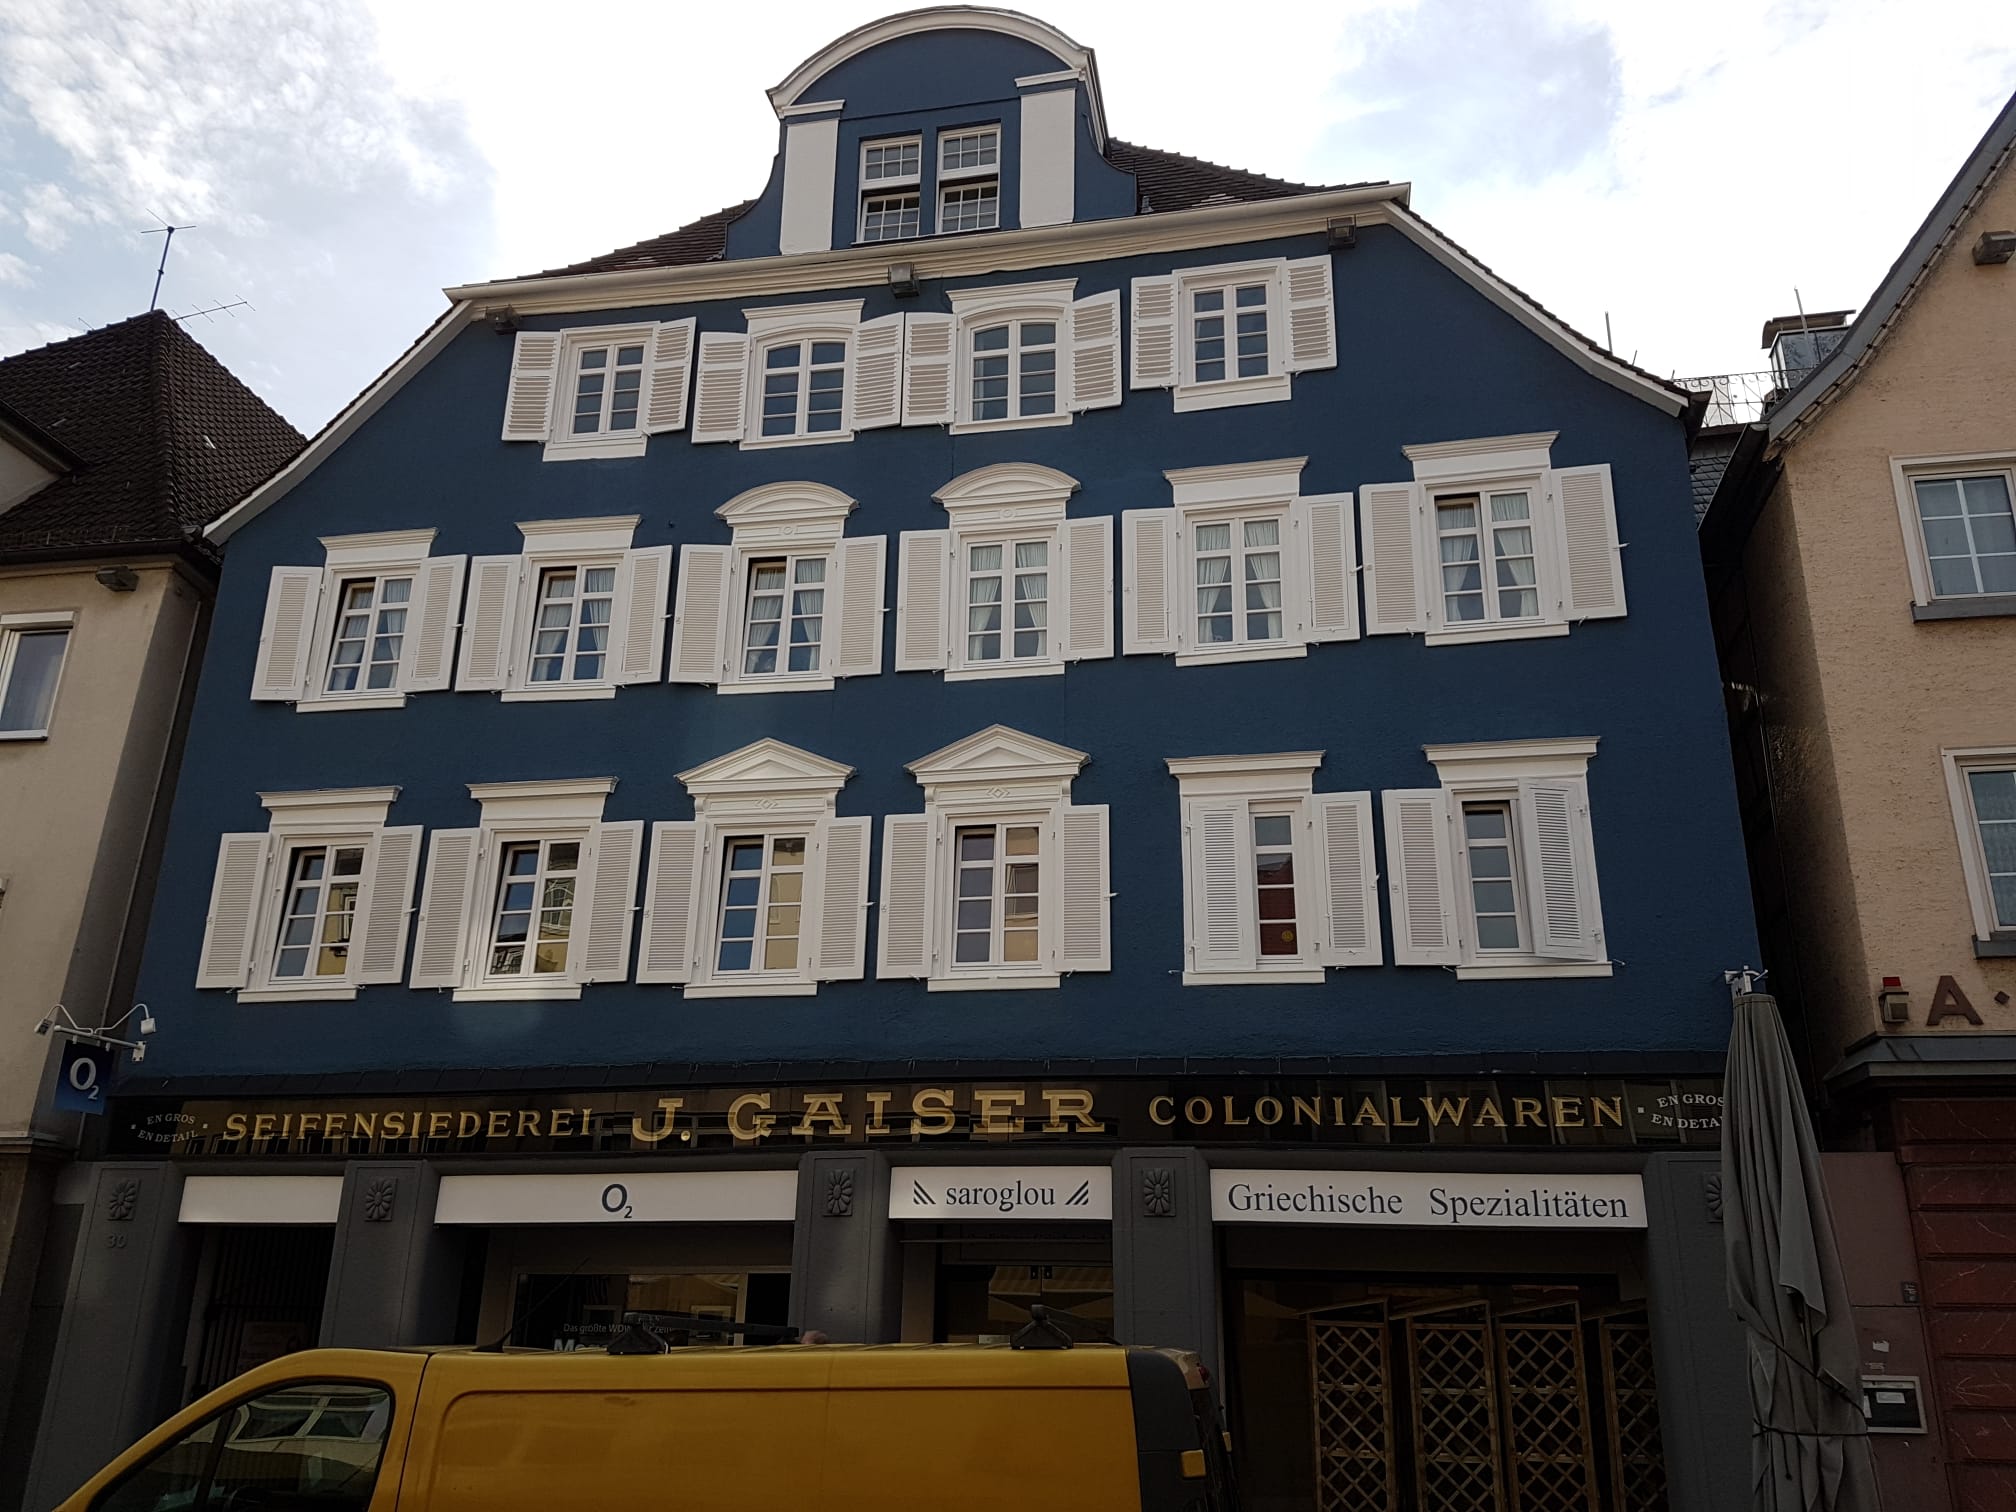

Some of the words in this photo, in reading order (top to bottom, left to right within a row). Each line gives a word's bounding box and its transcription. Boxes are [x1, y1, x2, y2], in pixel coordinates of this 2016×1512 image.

[1925, 974, 1985, 1026] A
[631, 1097, 692, 1143] J.
[726, 1088, 1106, 1139] GAISER
[1148, 1095, 1624, 1128] COLONIALWAREN
[1656, 1094, 1679, 1108] EN
[146, 1113, 163, 1126] EN
[165, 1112, 197, 1125] GROS
[222, 1106, 593, 1141] SEIFENSIEDEREI
[1651, 1113, 1674, 1127] EN
[1677, 1115, 1723, 1129] DETA
[138, 1129, 155, 1142] EN
[157, 1129, 199, 1143] DETAIL
[945, 1181, 1056, 1213] saroglou
[1227, 1183, 1403, 1215] Griechische
[1429, 1186, 1631, 1224] Spezialitäten
